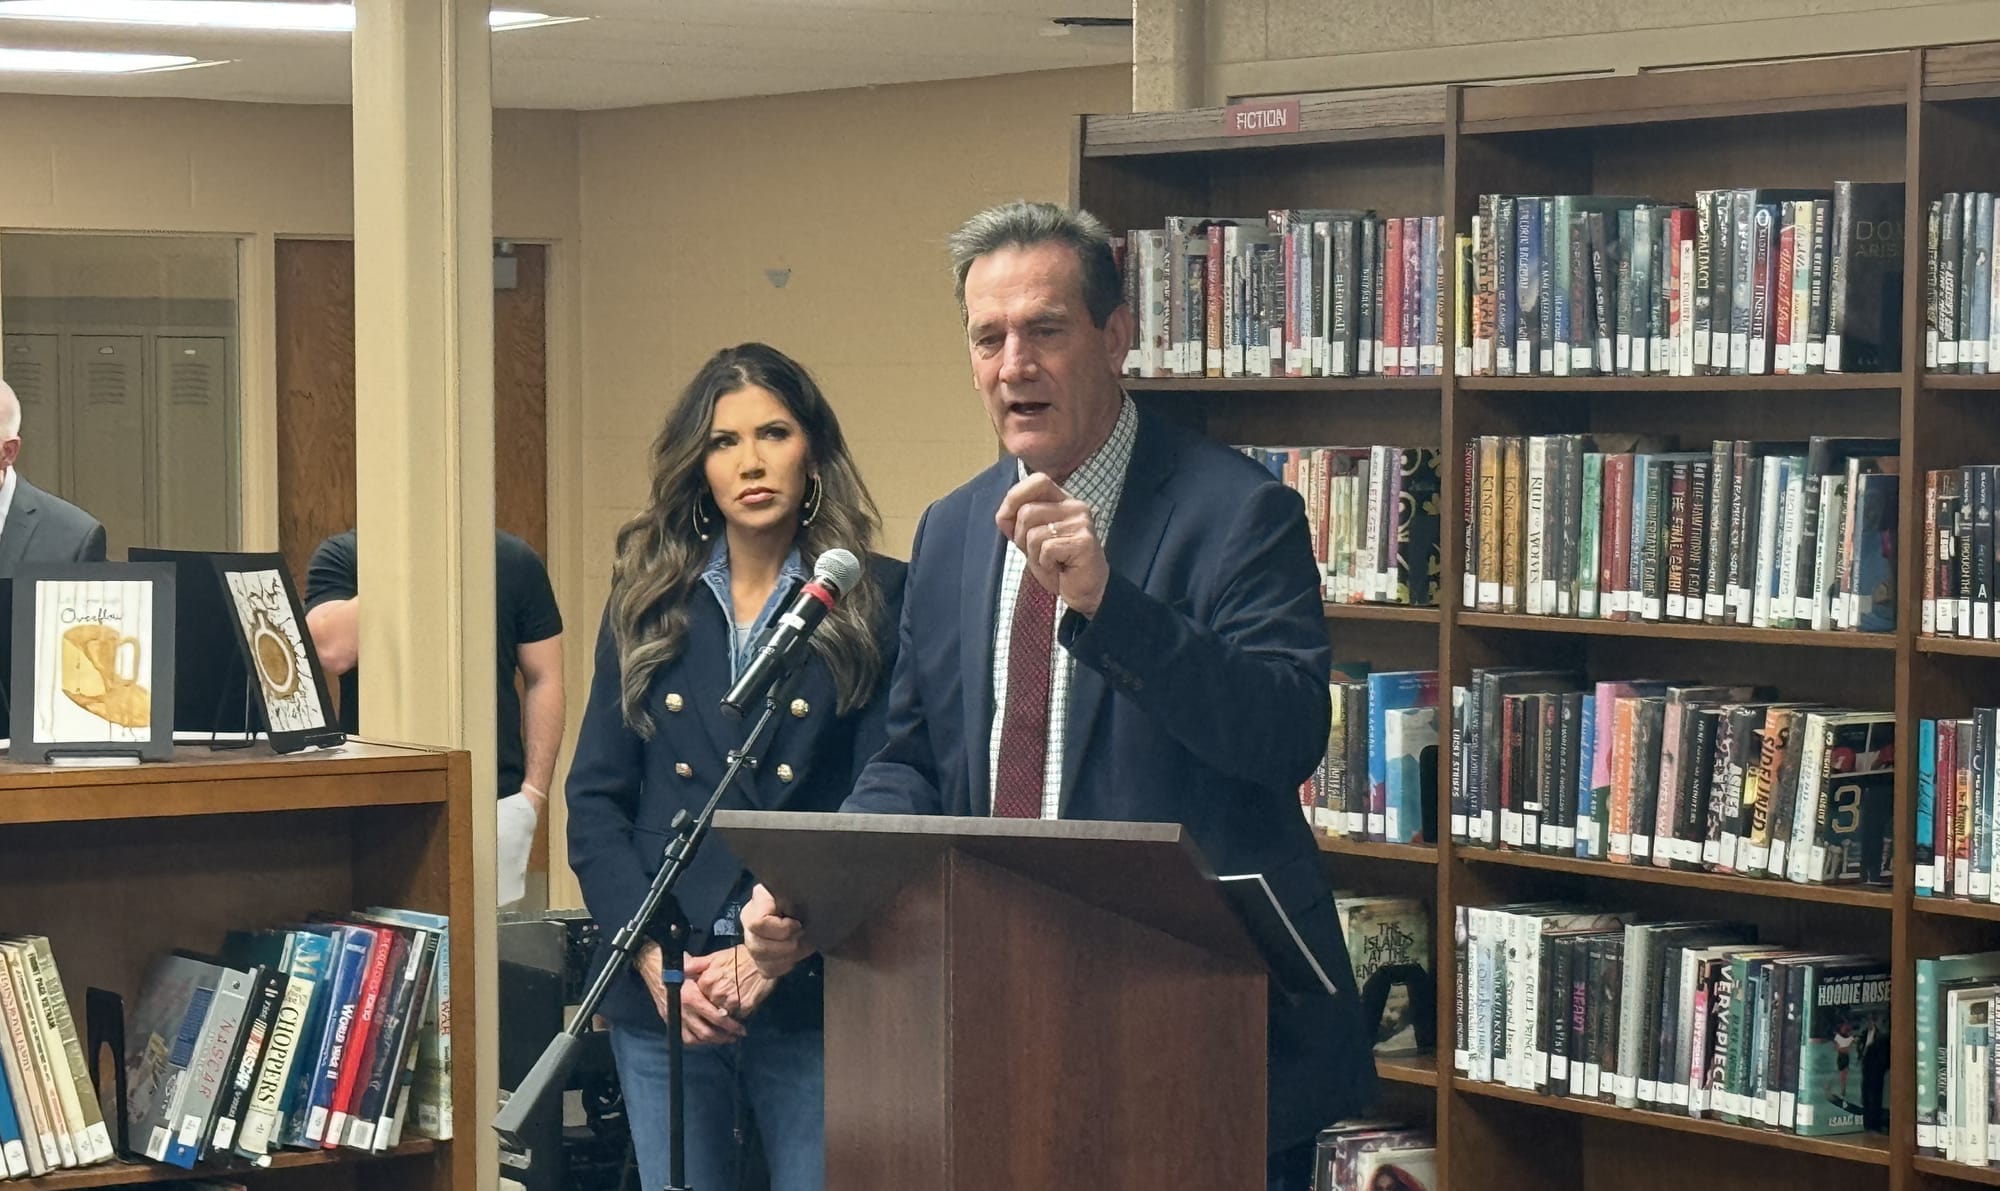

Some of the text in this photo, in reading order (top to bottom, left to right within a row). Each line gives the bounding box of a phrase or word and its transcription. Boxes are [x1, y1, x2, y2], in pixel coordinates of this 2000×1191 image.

[1236, 108, 1287, 130] FICTION
[1481, 475, 1494, 517] KING
[1503, 476, 1516, 518] KING
[1530, 477, 1543, 511] RULE
[1669, 517, 1684, 551] FINAL
[1689, 503, 1704, 563] HAWTHORNE
[1528, 530, 1542, 584] WOLVES
[1658, 762, 1671, 813] LOVELY
[1754, 735, 1775, 831] SIDELINED
[1831, 785, 1862, 834] 3
[1363, 932, 1414, 954] ISLANDS
[1377, 921, 1401, 935] THE
[1369, 949, 1382, 963] AT
[1818, 982, 1861, 1007] HOODIE
[334, 1003, 355, 1044] WORLD
[1523, 975, 1535, 1060] CRUEL PRINCE
[258, 1006, 299, 1104] CHOPPERS
[1829, 1115, 1854, 1127] ISAAC
